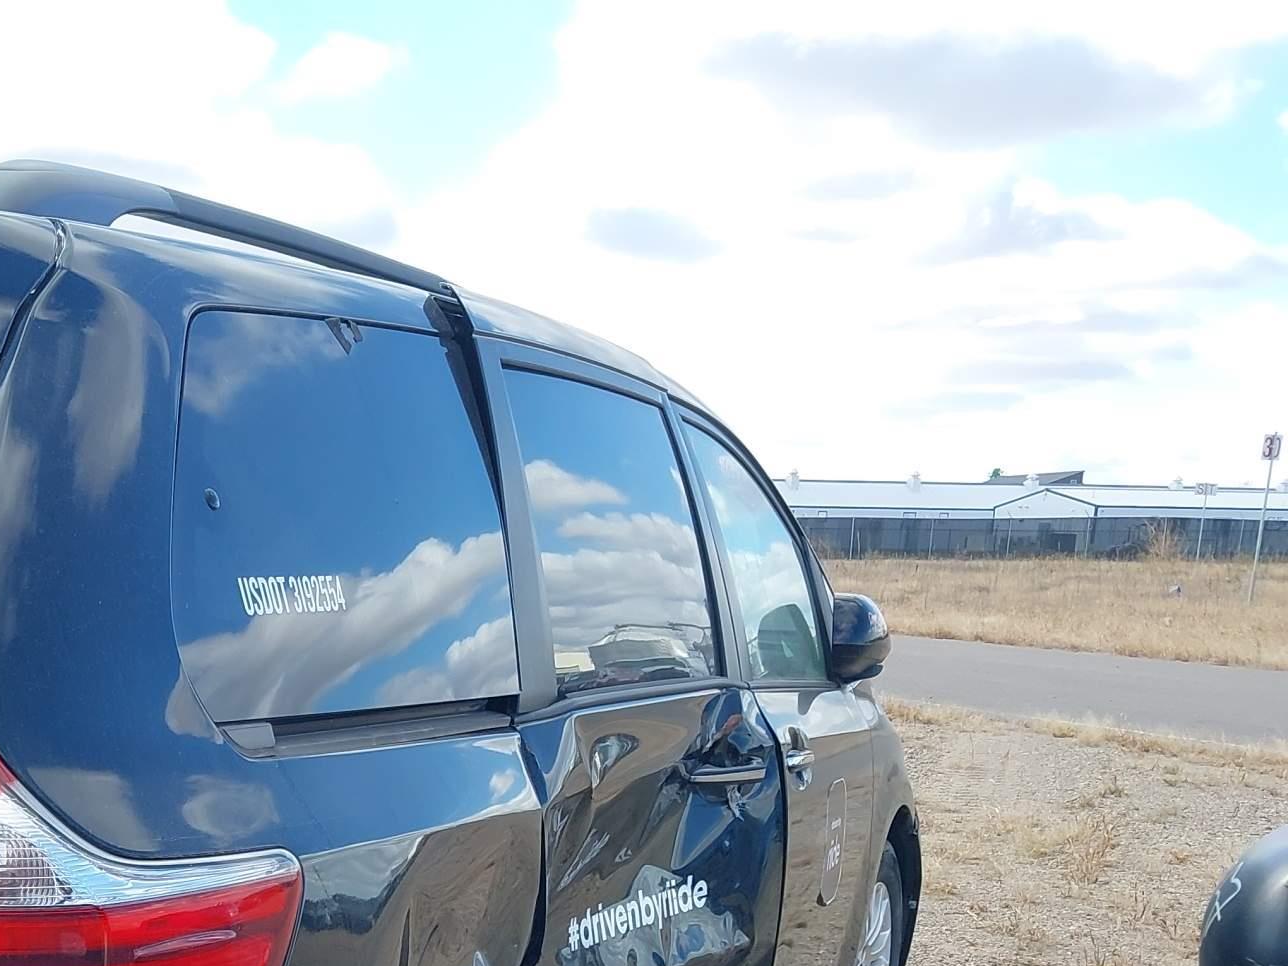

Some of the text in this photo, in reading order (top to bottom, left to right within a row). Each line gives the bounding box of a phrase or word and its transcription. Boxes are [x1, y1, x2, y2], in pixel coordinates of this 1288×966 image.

[237, 575, 346, 616] USDOT 3192554
[568, 874, 709, 952] #drivenbyriide
